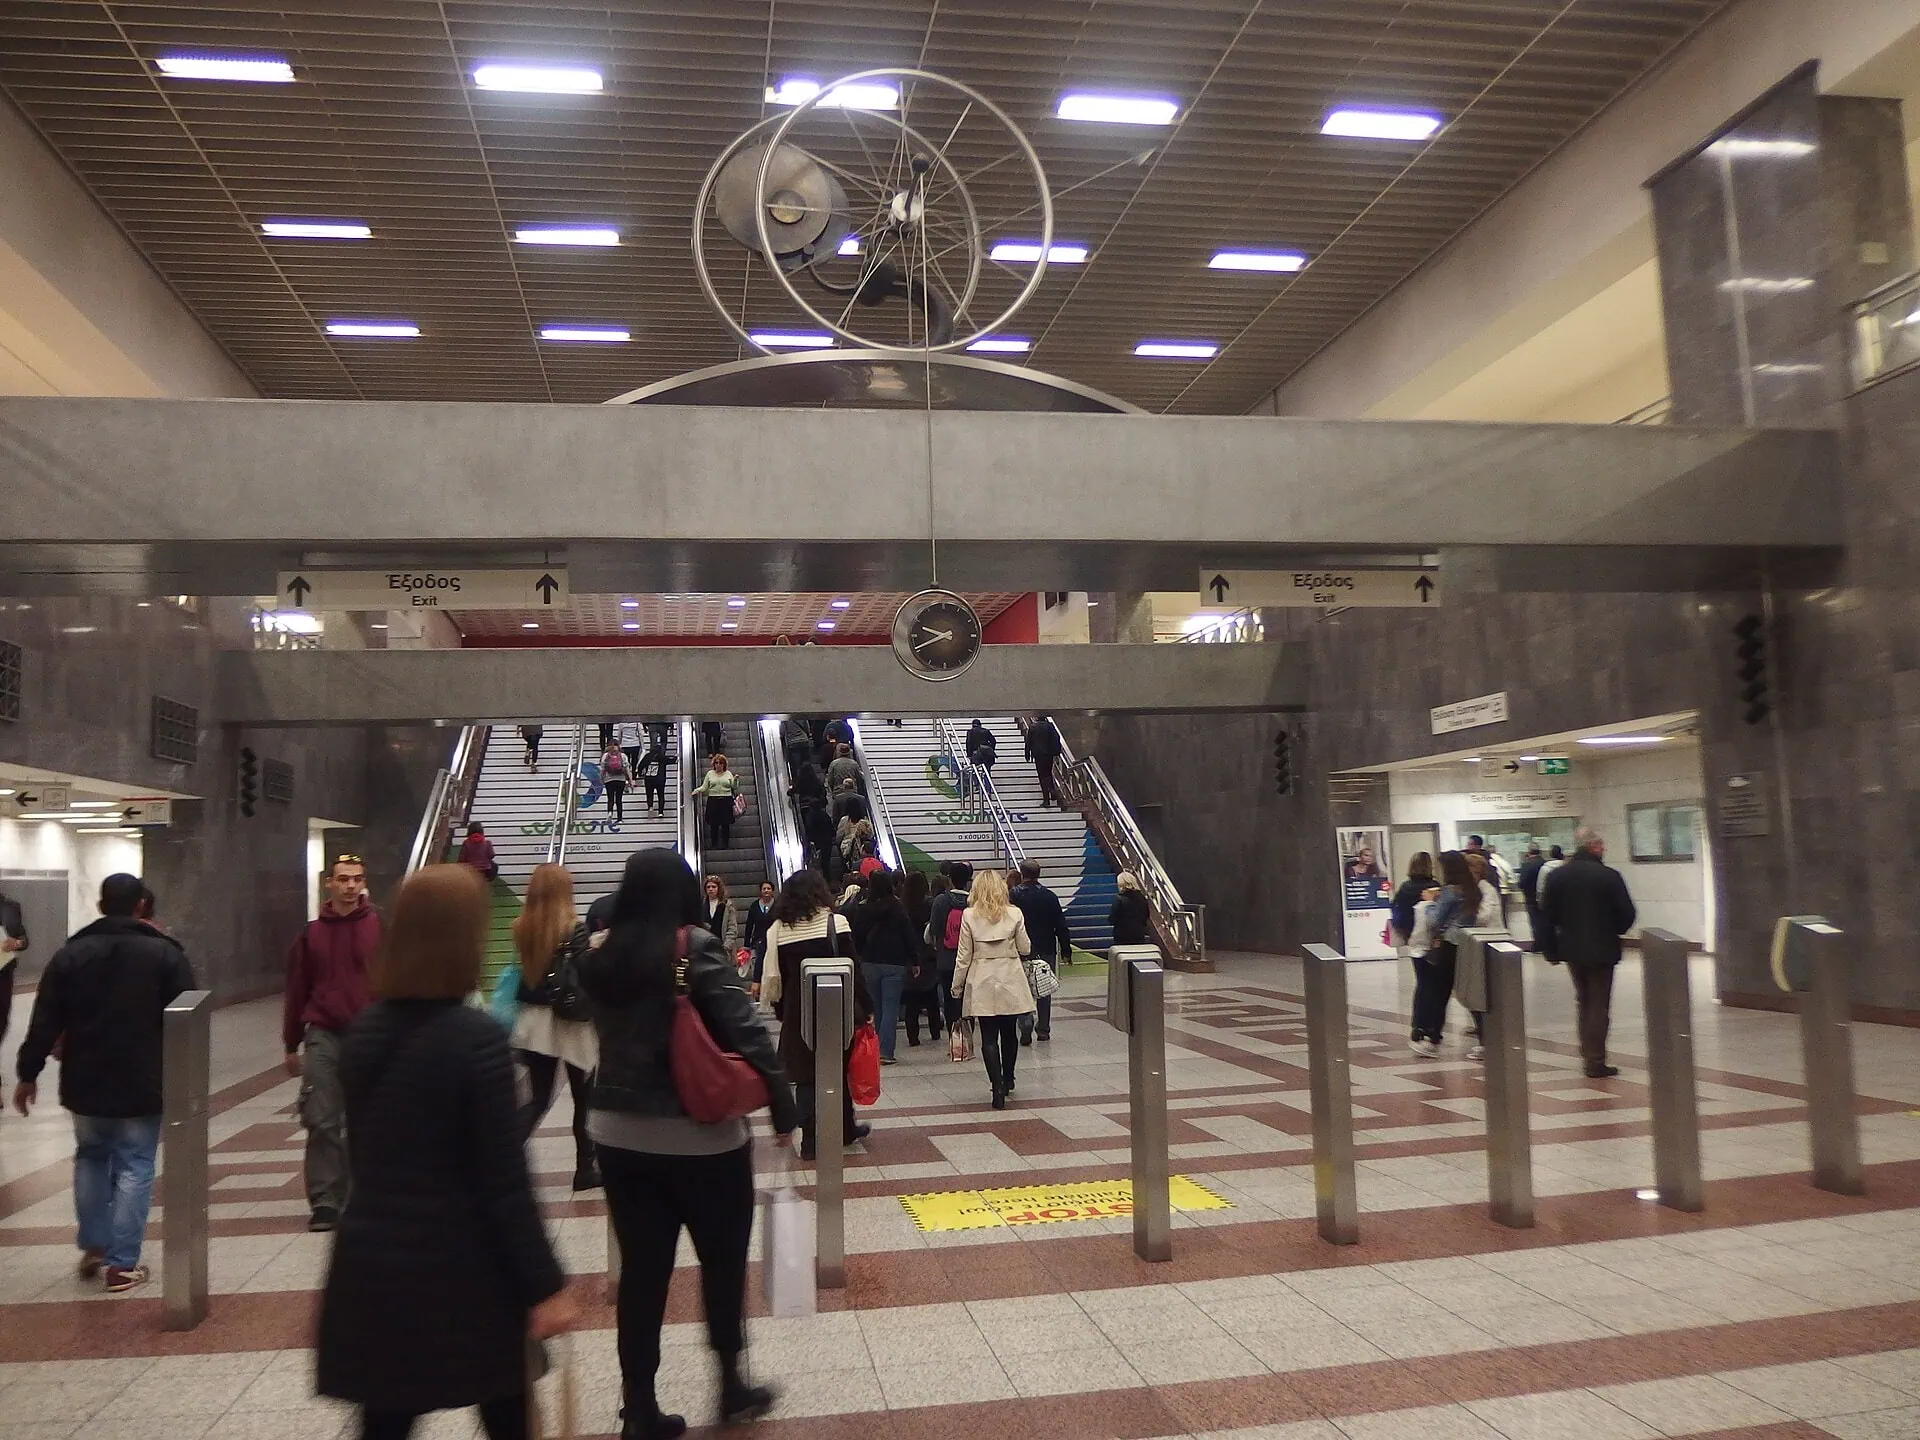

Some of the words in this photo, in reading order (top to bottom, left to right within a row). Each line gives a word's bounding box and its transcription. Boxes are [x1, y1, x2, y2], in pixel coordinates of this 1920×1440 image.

[385, 573, 461, 592] Έξοδος
[1290, 573, 1354, 590] Έξοδος
[411, 595, 437, 606] Exit
[1313, 593, 1335, 603] Exit
[1006, 1203, 1132, 1222] STOP
